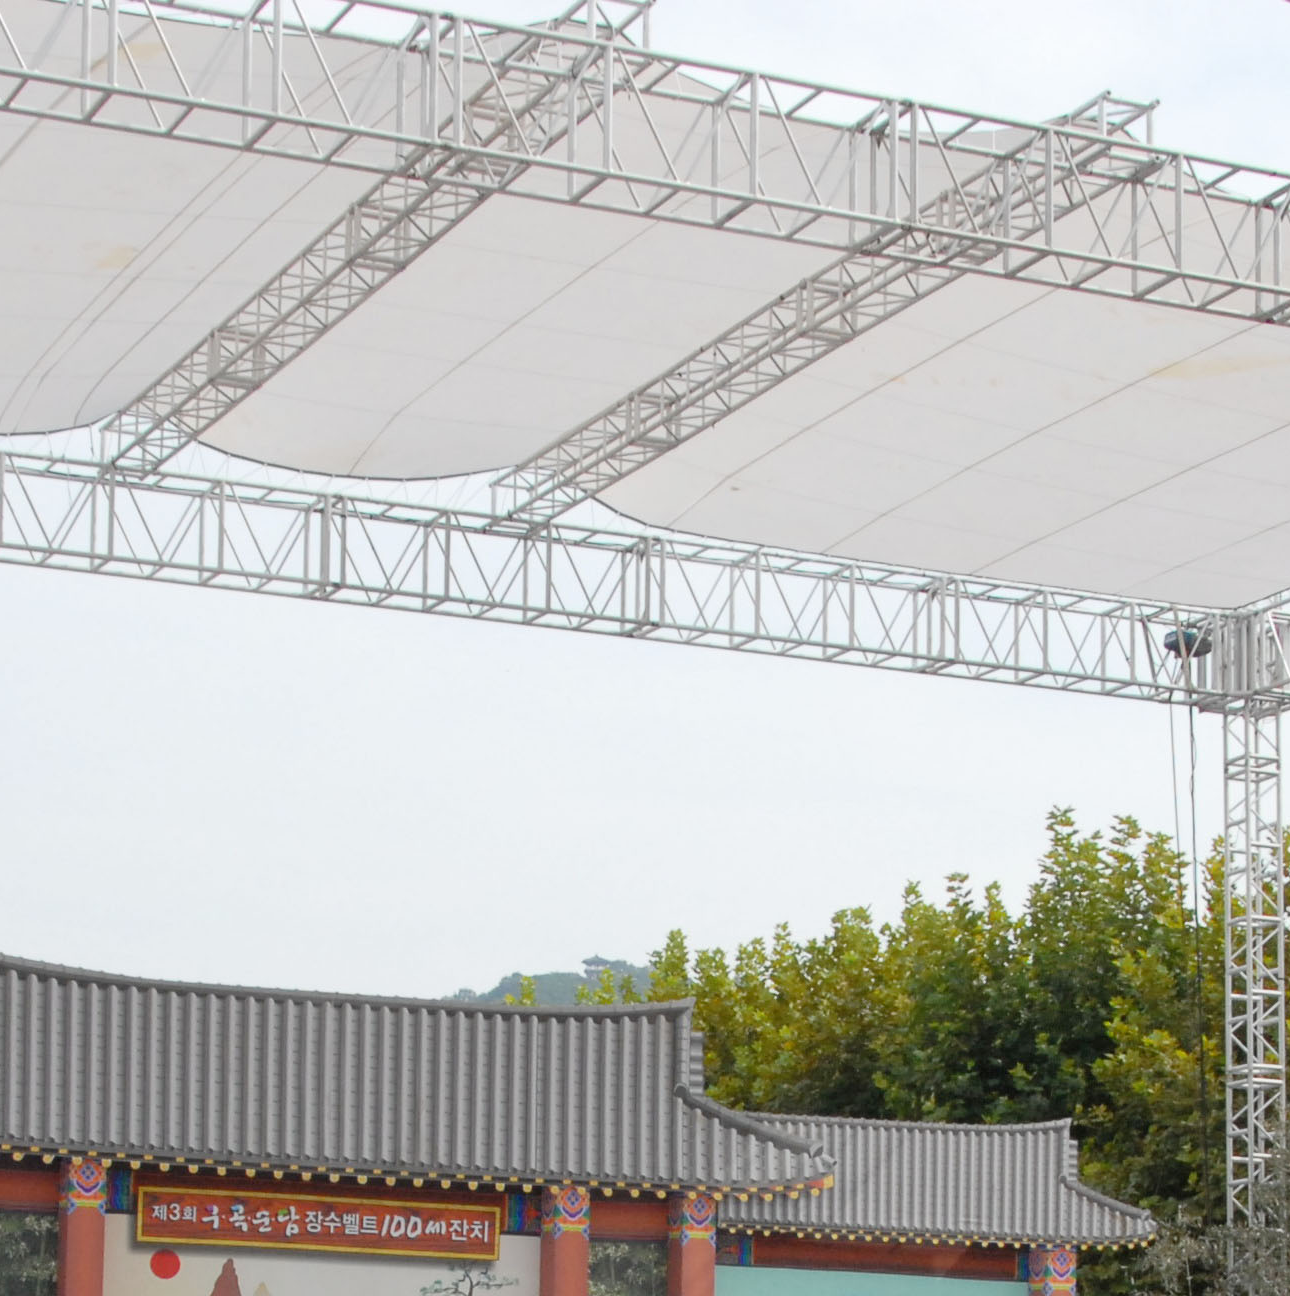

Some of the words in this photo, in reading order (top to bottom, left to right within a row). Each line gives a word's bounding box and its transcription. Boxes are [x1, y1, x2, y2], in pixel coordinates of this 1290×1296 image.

[151, 1203, 198, 1223] 제3회
[304, 1210, 379, 1237] 장수벨트
[449, 1218, 491, 1243] 잔치
